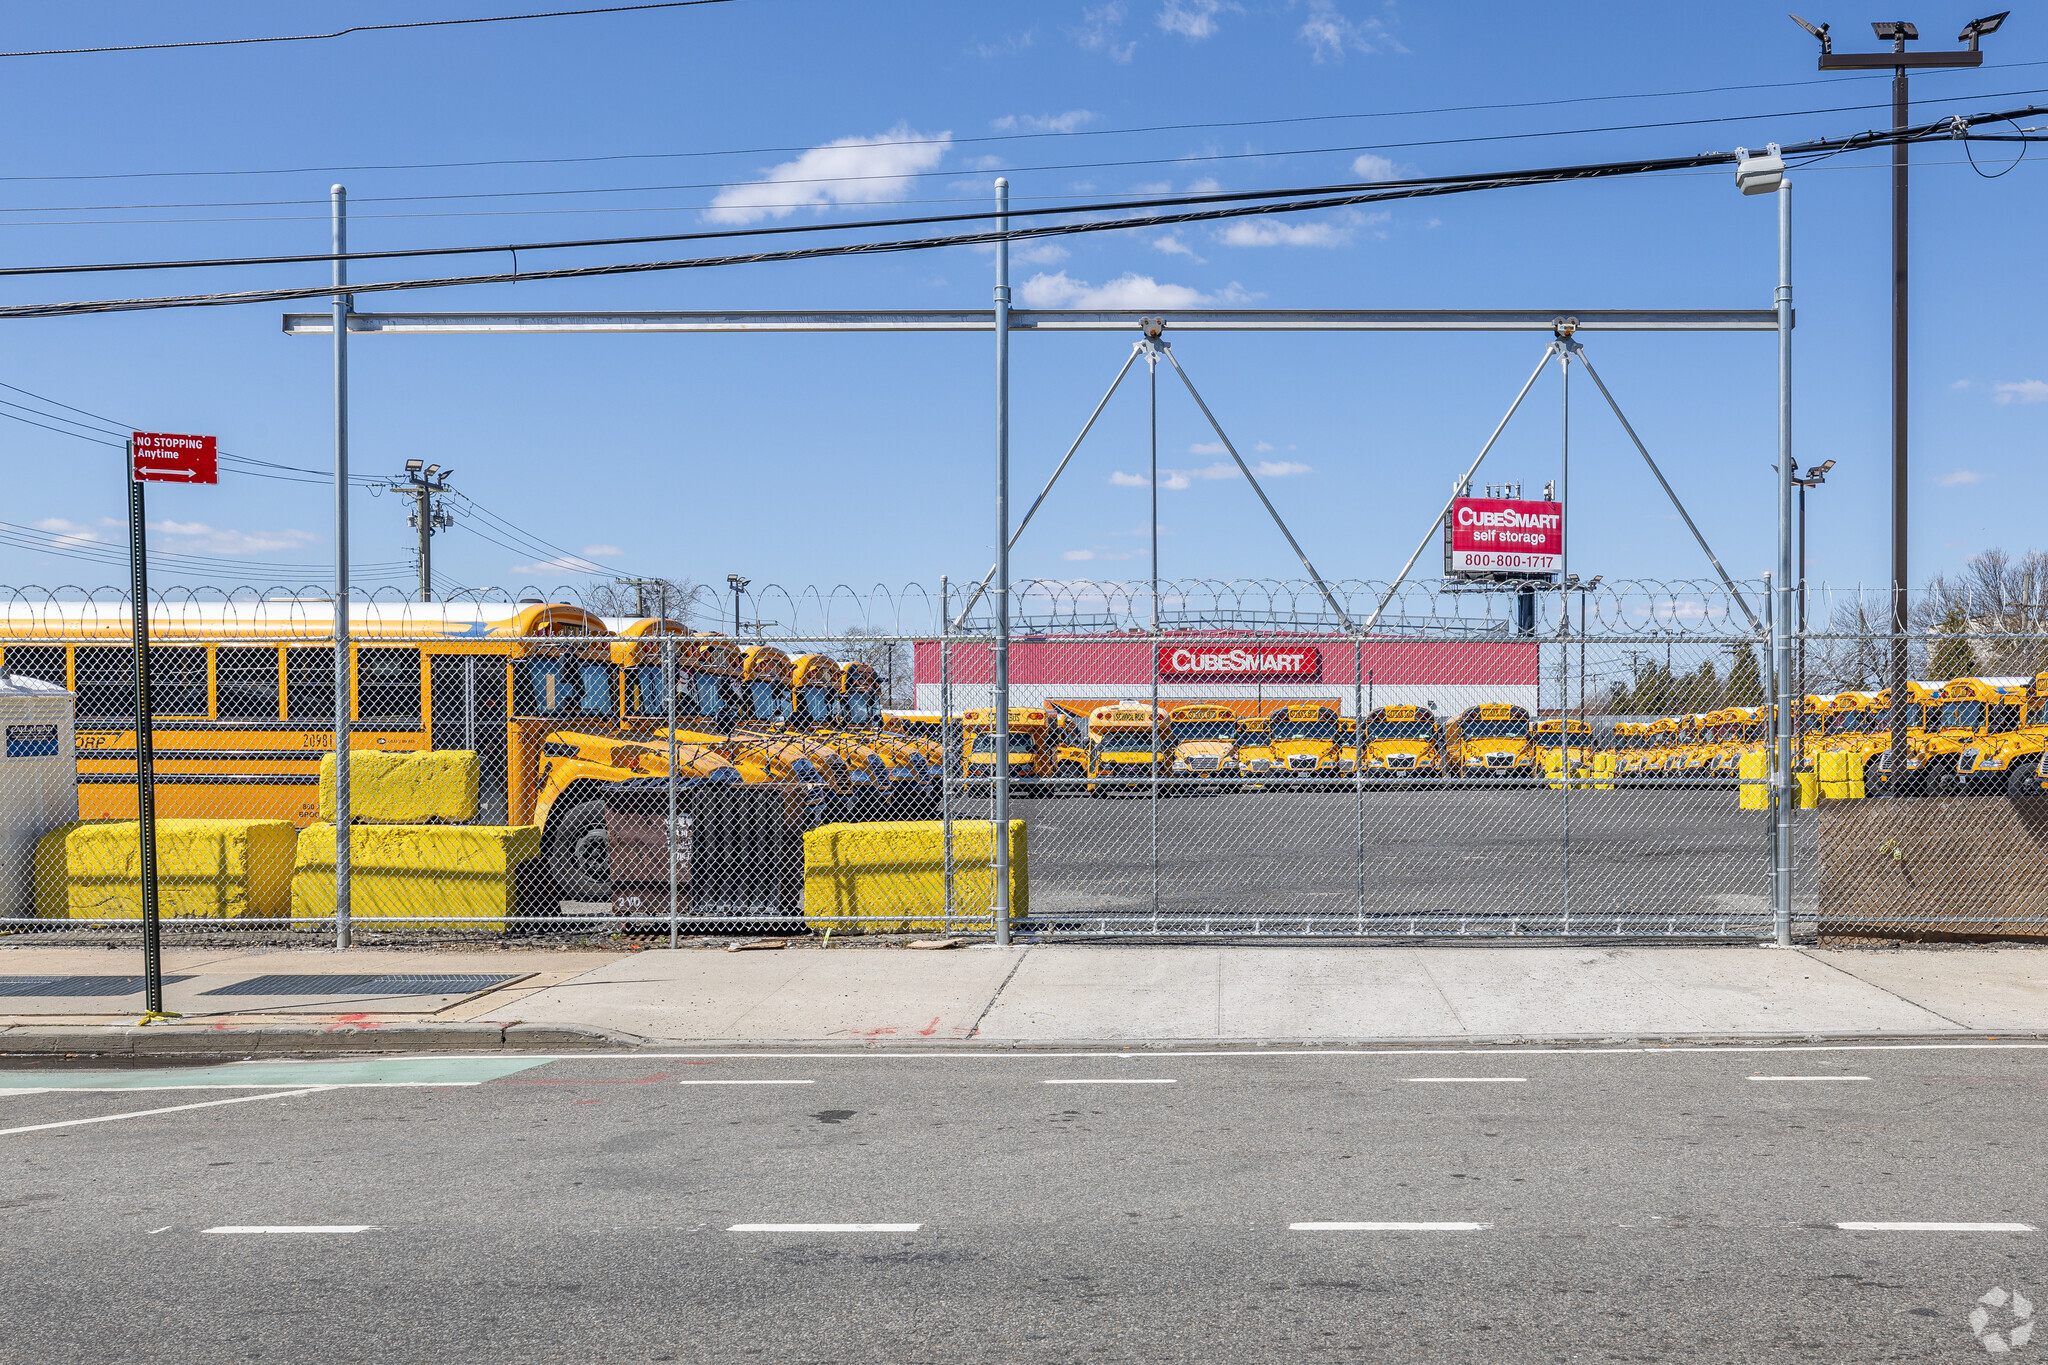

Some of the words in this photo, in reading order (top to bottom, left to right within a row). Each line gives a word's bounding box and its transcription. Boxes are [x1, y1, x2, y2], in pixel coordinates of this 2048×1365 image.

[137, 436, 151, 446] NO
[154, 437, 203, 449] STOPPING
[138, 448, 179, 460] Anytime
[1473, 529, 1497, 541] self
[1499, 530, 1546, 545] storage
[1465, 554, 1553, 568] 800-800-1717
[76, 736, 106, 748] ORP
